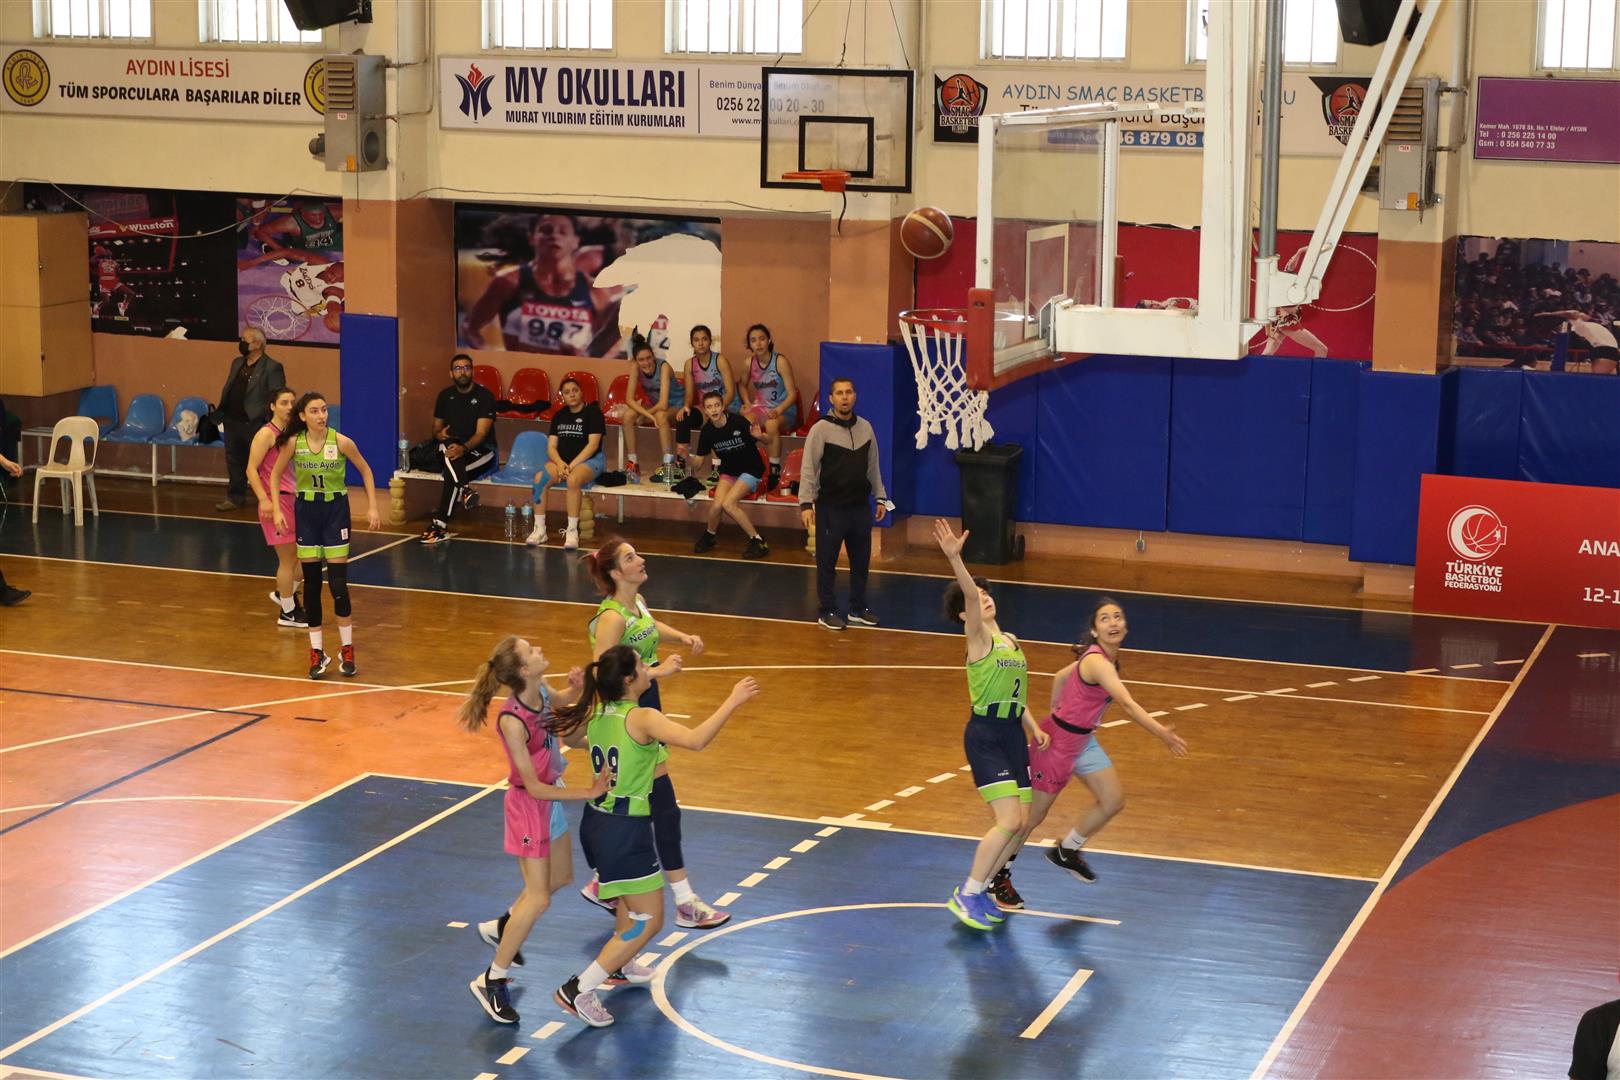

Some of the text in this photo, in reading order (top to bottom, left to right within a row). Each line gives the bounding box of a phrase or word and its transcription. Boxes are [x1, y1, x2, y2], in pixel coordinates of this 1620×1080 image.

[126, 57, 230, 78] AYDIN LİSESİ
[505, 66, 685, 108] MY OKULLARI
[709, 80, 735, 89] Benim
[737, 80, 763, 91] Dünya
[58, 81, 301, 106] TÜM SPORCULARA BAŞARILAR DİLER
[1002, 84, 1061, 100] AYDIN
[1123, 86, 1205, 103] BASKETB
[716, 97, 744, 111] 0256
[746, 98, 764, 112] 22
[505, 109, 685, 128] MURAT YILDIRIM EĞİTİM KURUMLARI
[1340, 116, 1357, 127] SMA
[1139, 132, 1171, 146] 879
[1175, 133, 1197, 146] 08
[1479, 130, 1489, 138] Tel
[1478, 140, 1494, 148] Gsm
[128, 222, 174, 232] Winston
[295, 279, 305, 288] 8
[527, 303, 589, 322] TOYOTA
[771, 390, 778, 401] 3
[311, 474, 325, 489] 11
[1446, 559, 1503, 577] TÜRKİYE
[1444, 580, 1502, 592] FEDERASYONU
[1445, 572, 1502, 586] BASKETBOL
[1012, 678, 1021, 698] 2
